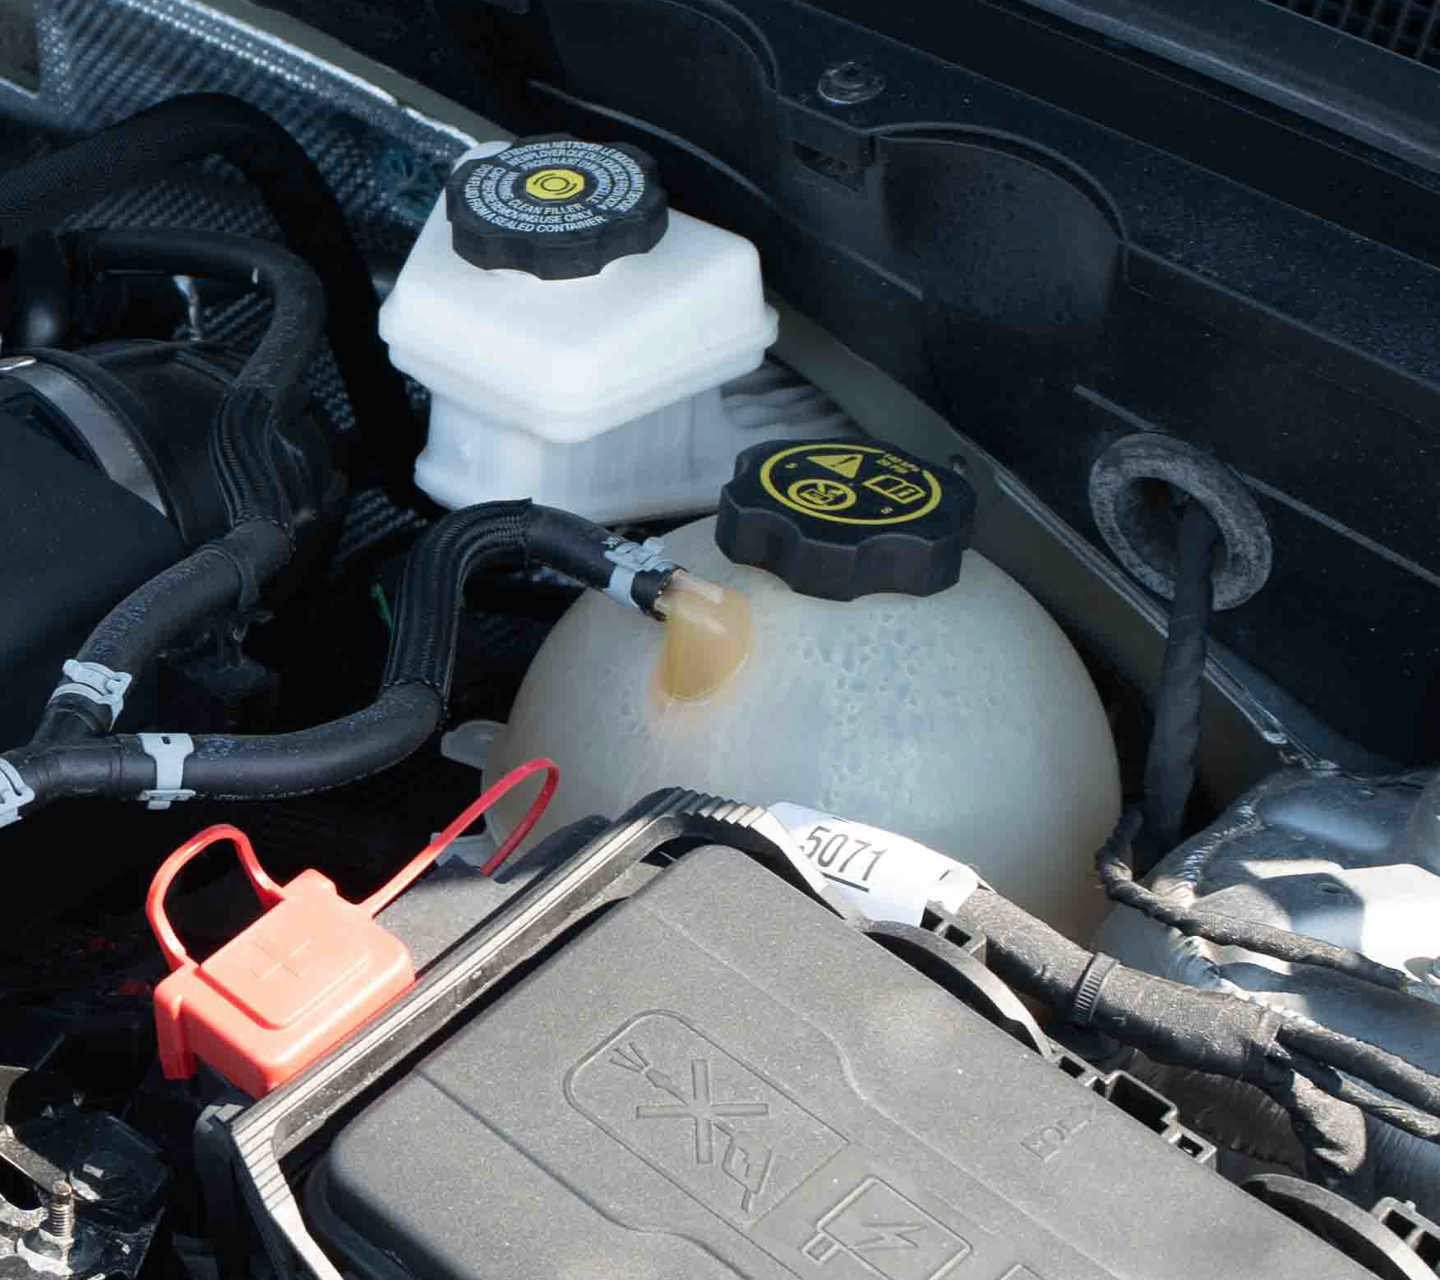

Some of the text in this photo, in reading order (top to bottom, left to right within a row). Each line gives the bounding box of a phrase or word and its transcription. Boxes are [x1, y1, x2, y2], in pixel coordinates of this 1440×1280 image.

[508, 195, 541, 214] CLEAN
[491, 214, 534, 231] SEALED
[564, 209, 593, 222] ONLY
[800, 825, 888, 881] 5071
